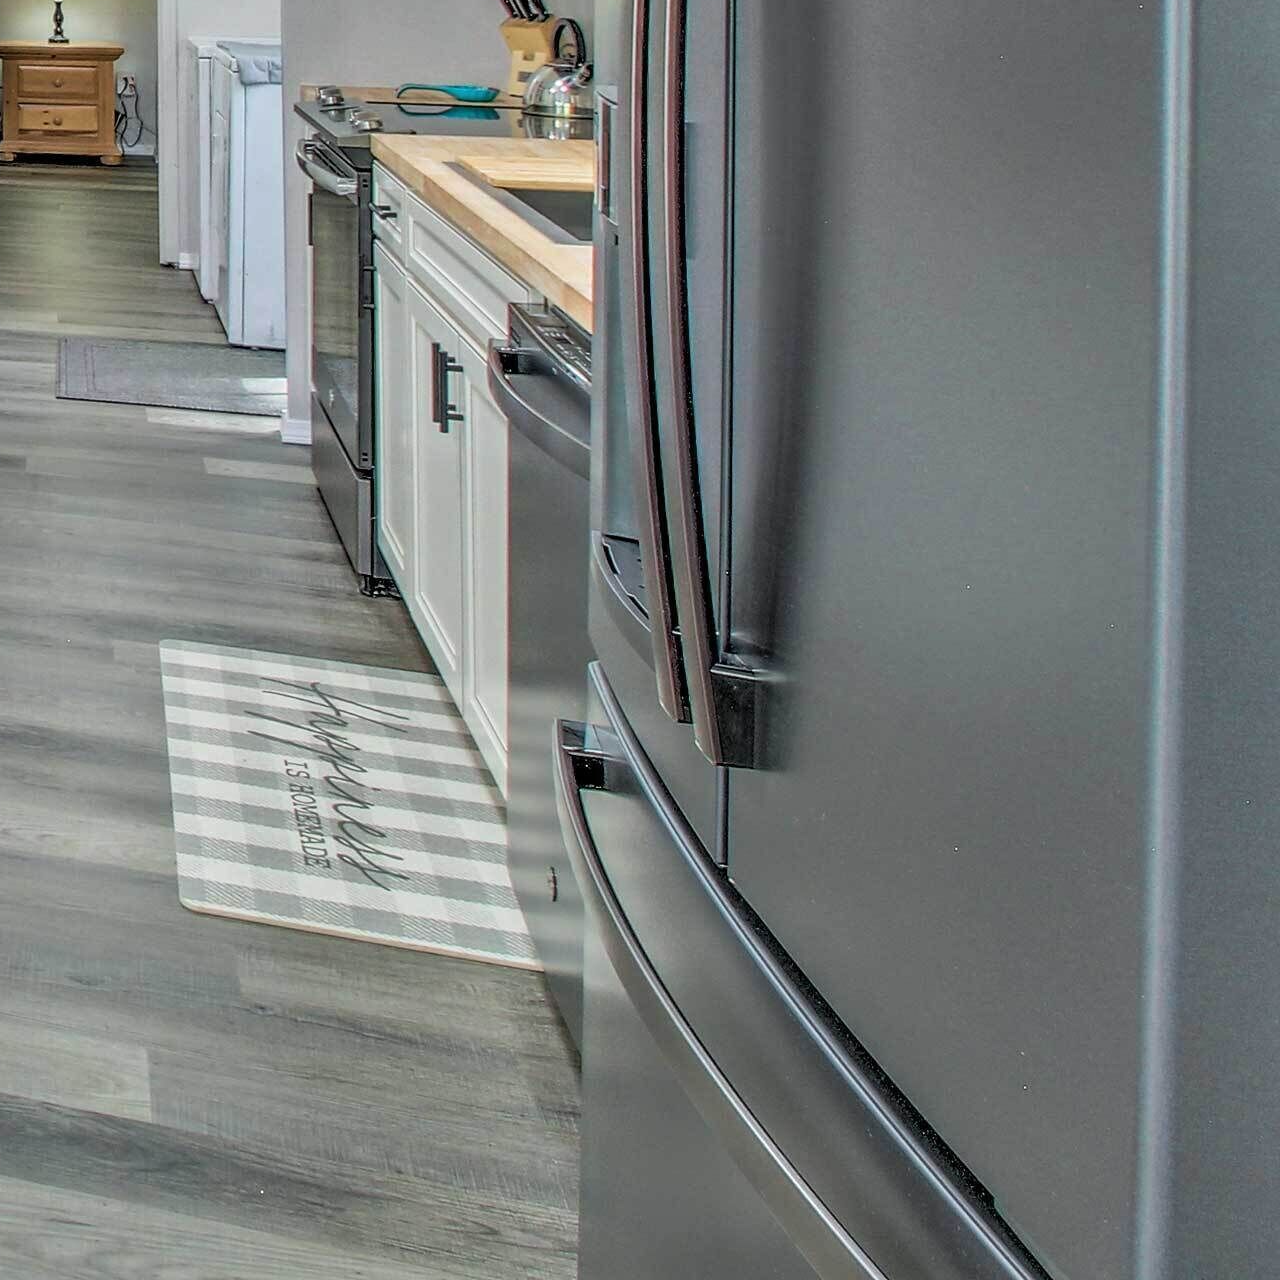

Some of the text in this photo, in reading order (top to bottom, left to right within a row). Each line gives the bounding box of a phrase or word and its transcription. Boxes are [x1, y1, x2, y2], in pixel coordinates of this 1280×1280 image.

[244, 677, 410, 891] Happiness
[284, 759, 332, 870] IS HOMEMADE
